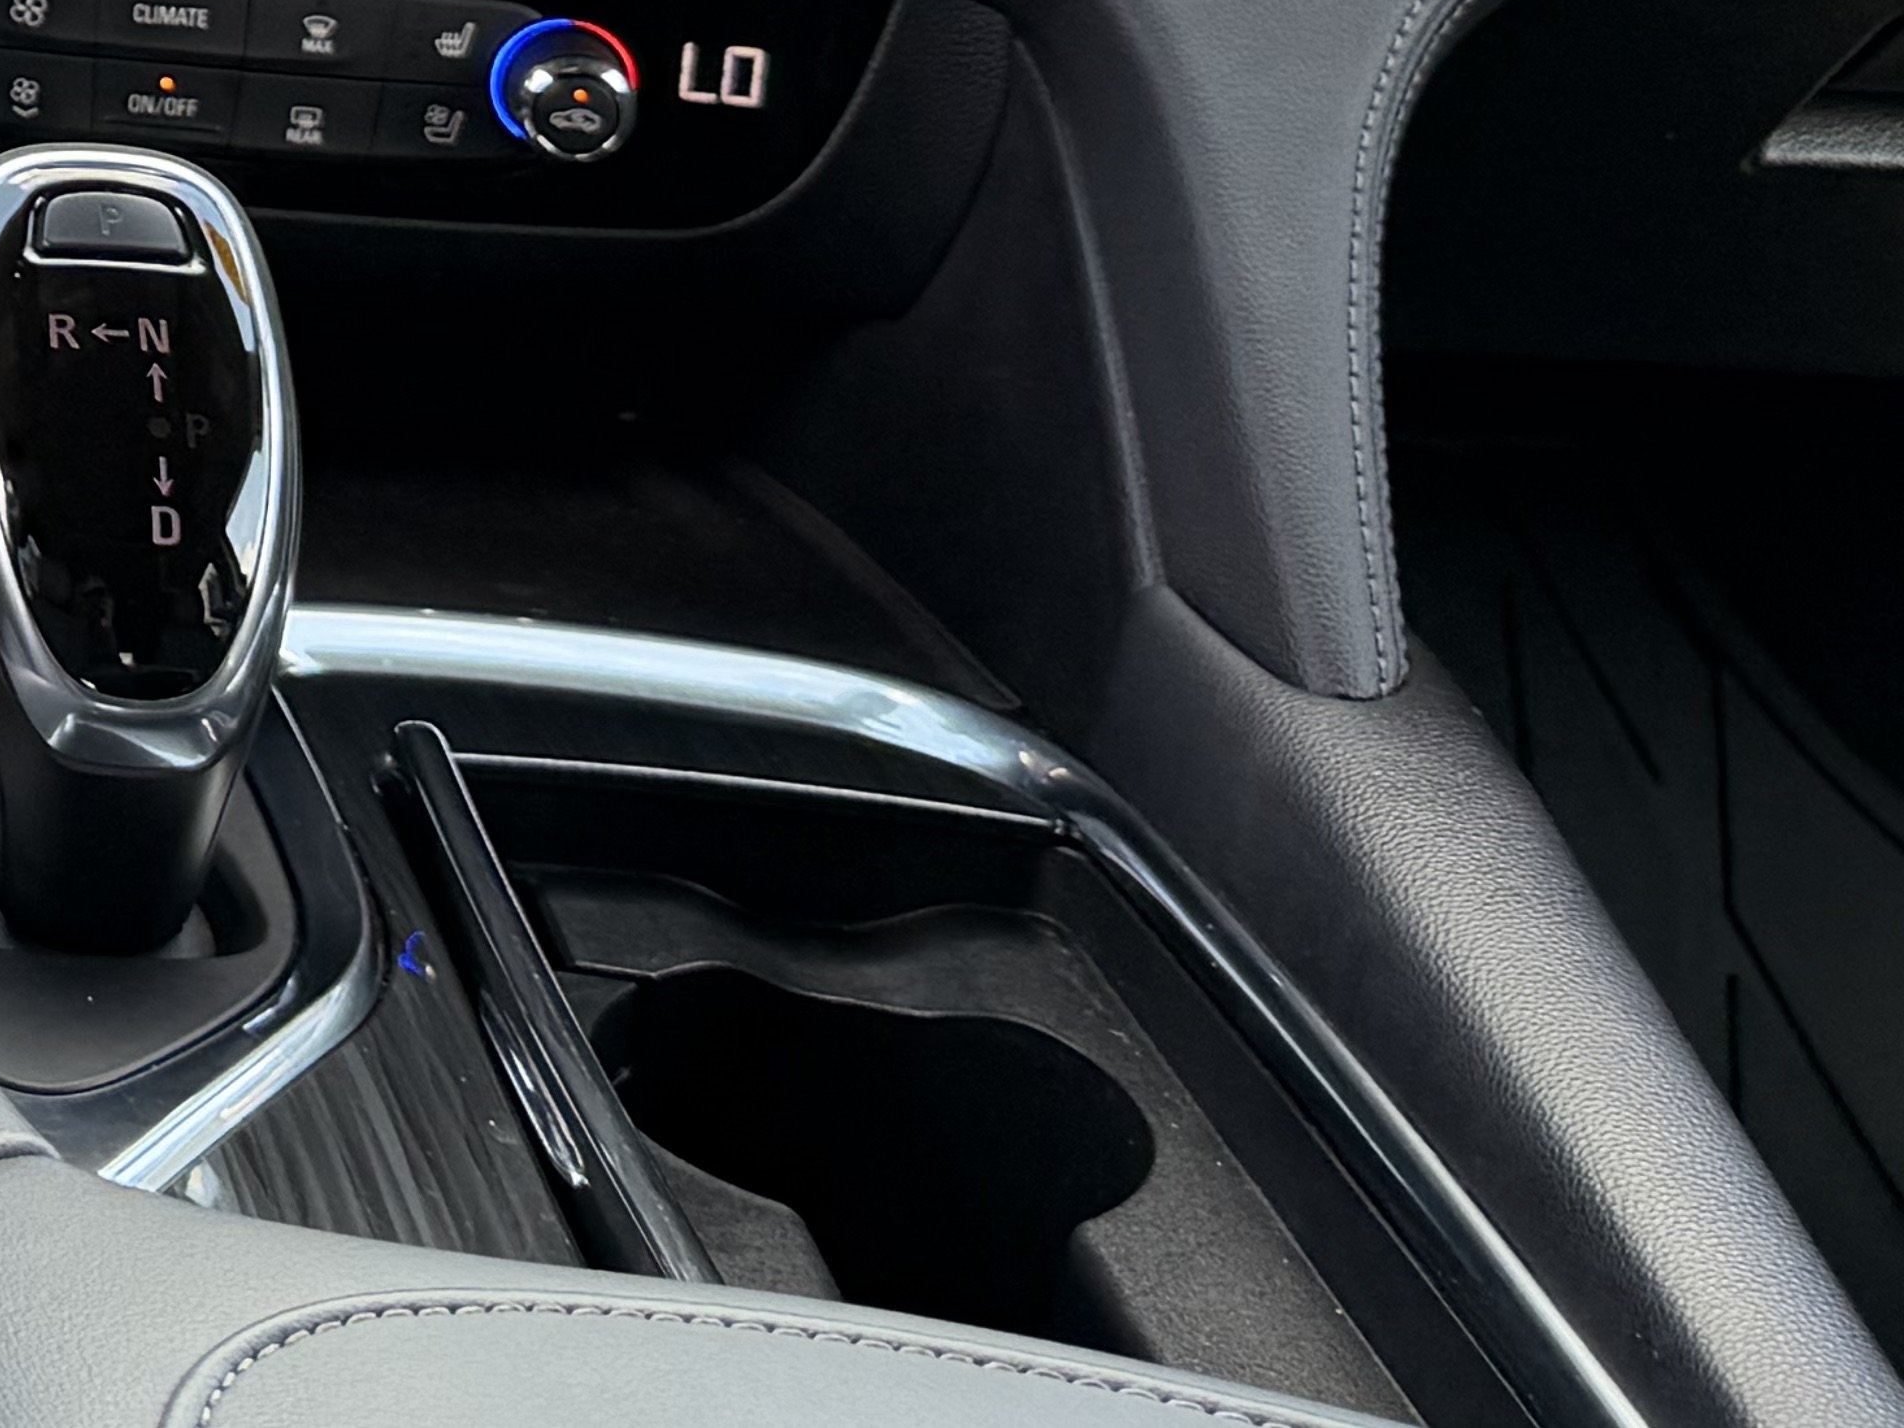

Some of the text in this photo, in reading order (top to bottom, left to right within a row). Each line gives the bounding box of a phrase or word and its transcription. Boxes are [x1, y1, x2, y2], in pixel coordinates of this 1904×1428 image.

[132, 3, 208, 30] CLIMATE
[301, 38, 334, 55] MAX
[128, 94, 198, 118] ON/OFF
[285, 128, 323, 144] REAR
[48, 314, 171, 354] R N
[151, 505, 182, 546] D
